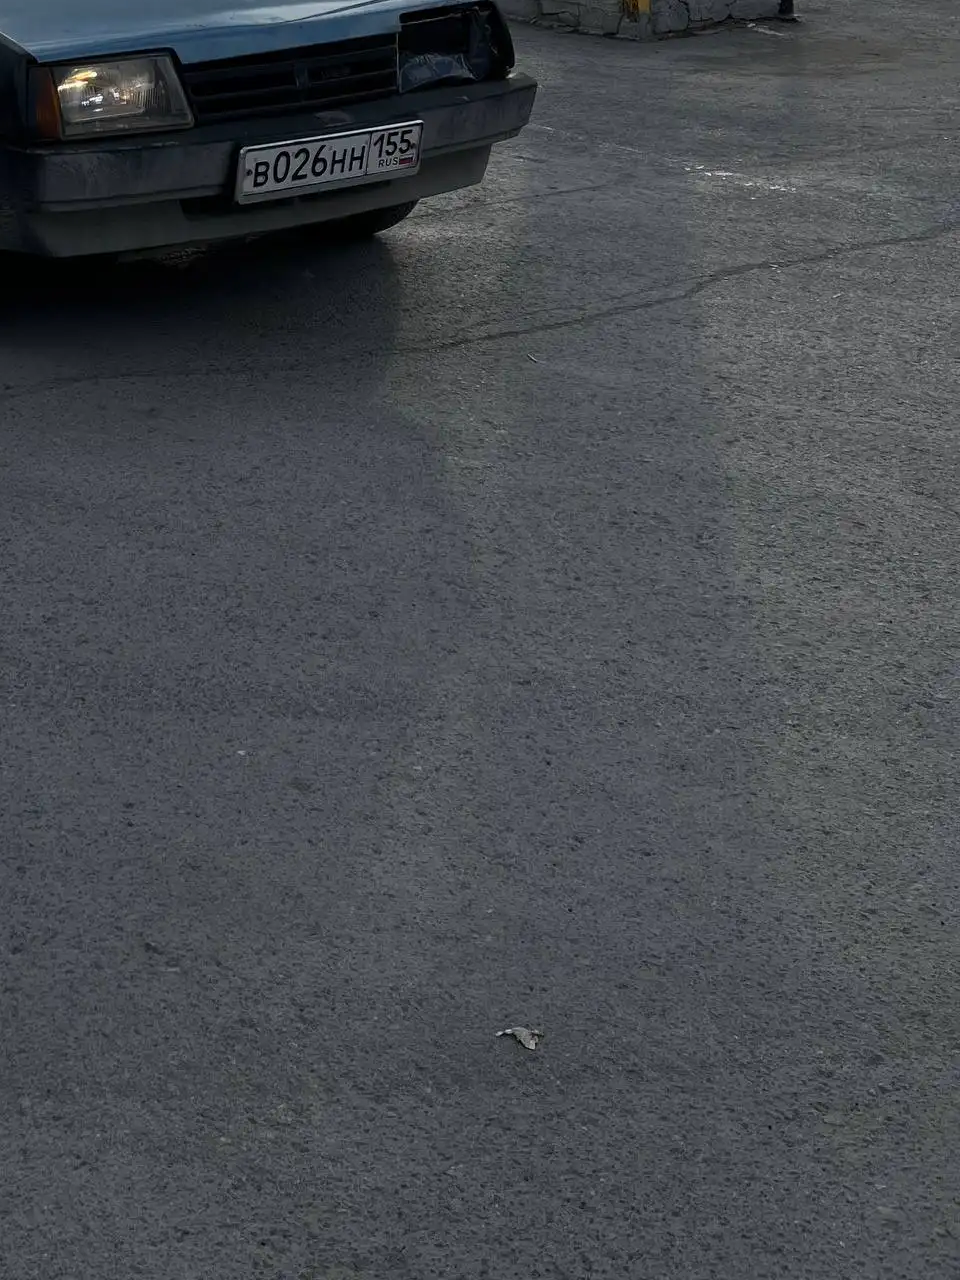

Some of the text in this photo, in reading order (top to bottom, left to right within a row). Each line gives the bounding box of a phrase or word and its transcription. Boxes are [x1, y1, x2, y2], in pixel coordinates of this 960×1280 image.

[252, 129, 413, 188] В026НН 155
[378, 157, 399, 168] RUS
